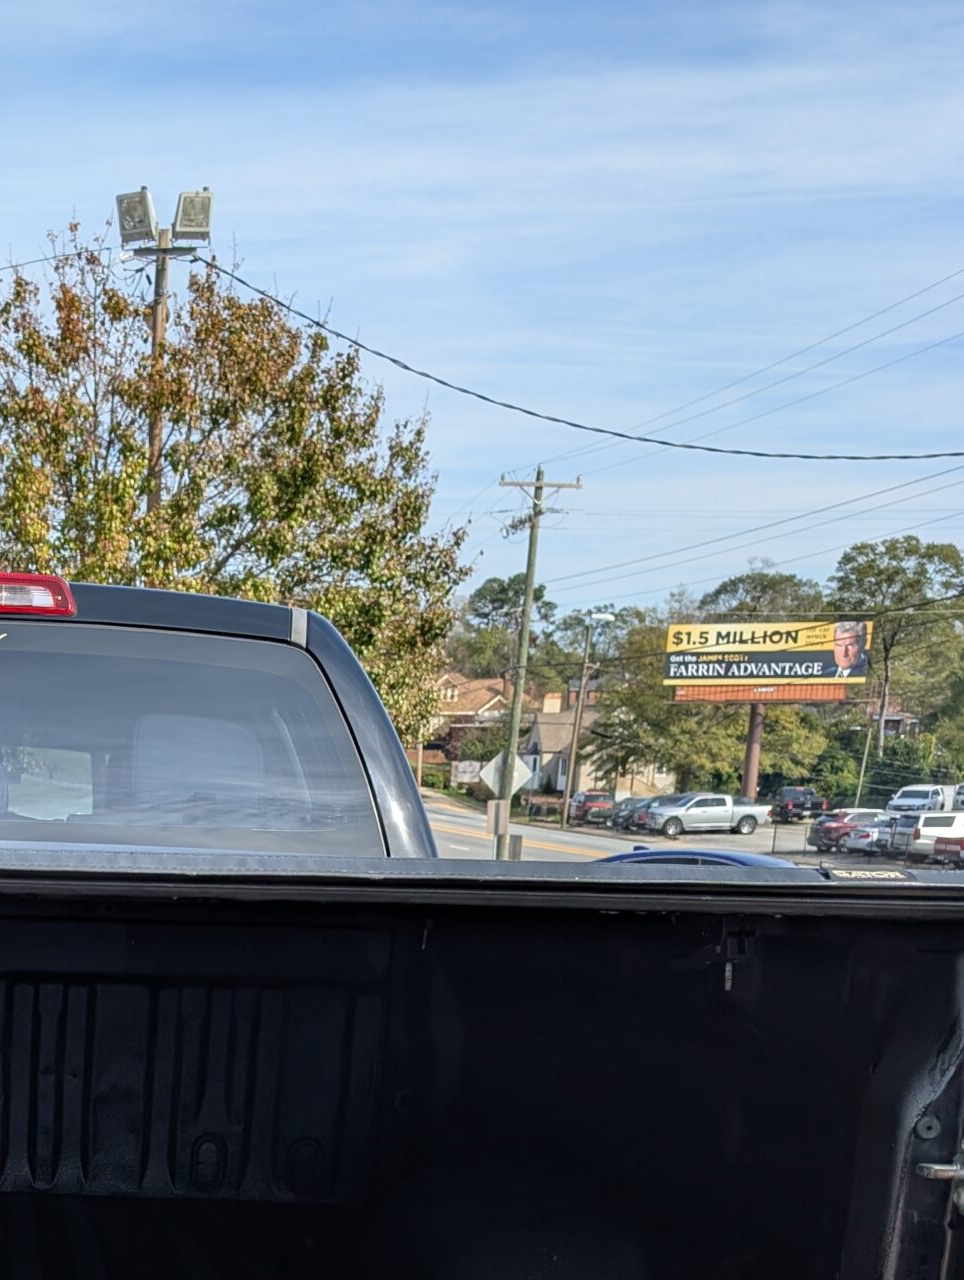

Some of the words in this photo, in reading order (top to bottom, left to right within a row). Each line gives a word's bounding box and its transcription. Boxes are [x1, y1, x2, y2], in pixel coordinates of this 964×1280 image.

[672, 631, 709, 646] $1.5
[716, 630, 799, 645] MILLION
[669, 655, 683, 663] Get
[684, 655, 697, 663] the
[669, 663, 726, 677] FARRIN
[728, 662, 823, 676] ADVANTAGE
